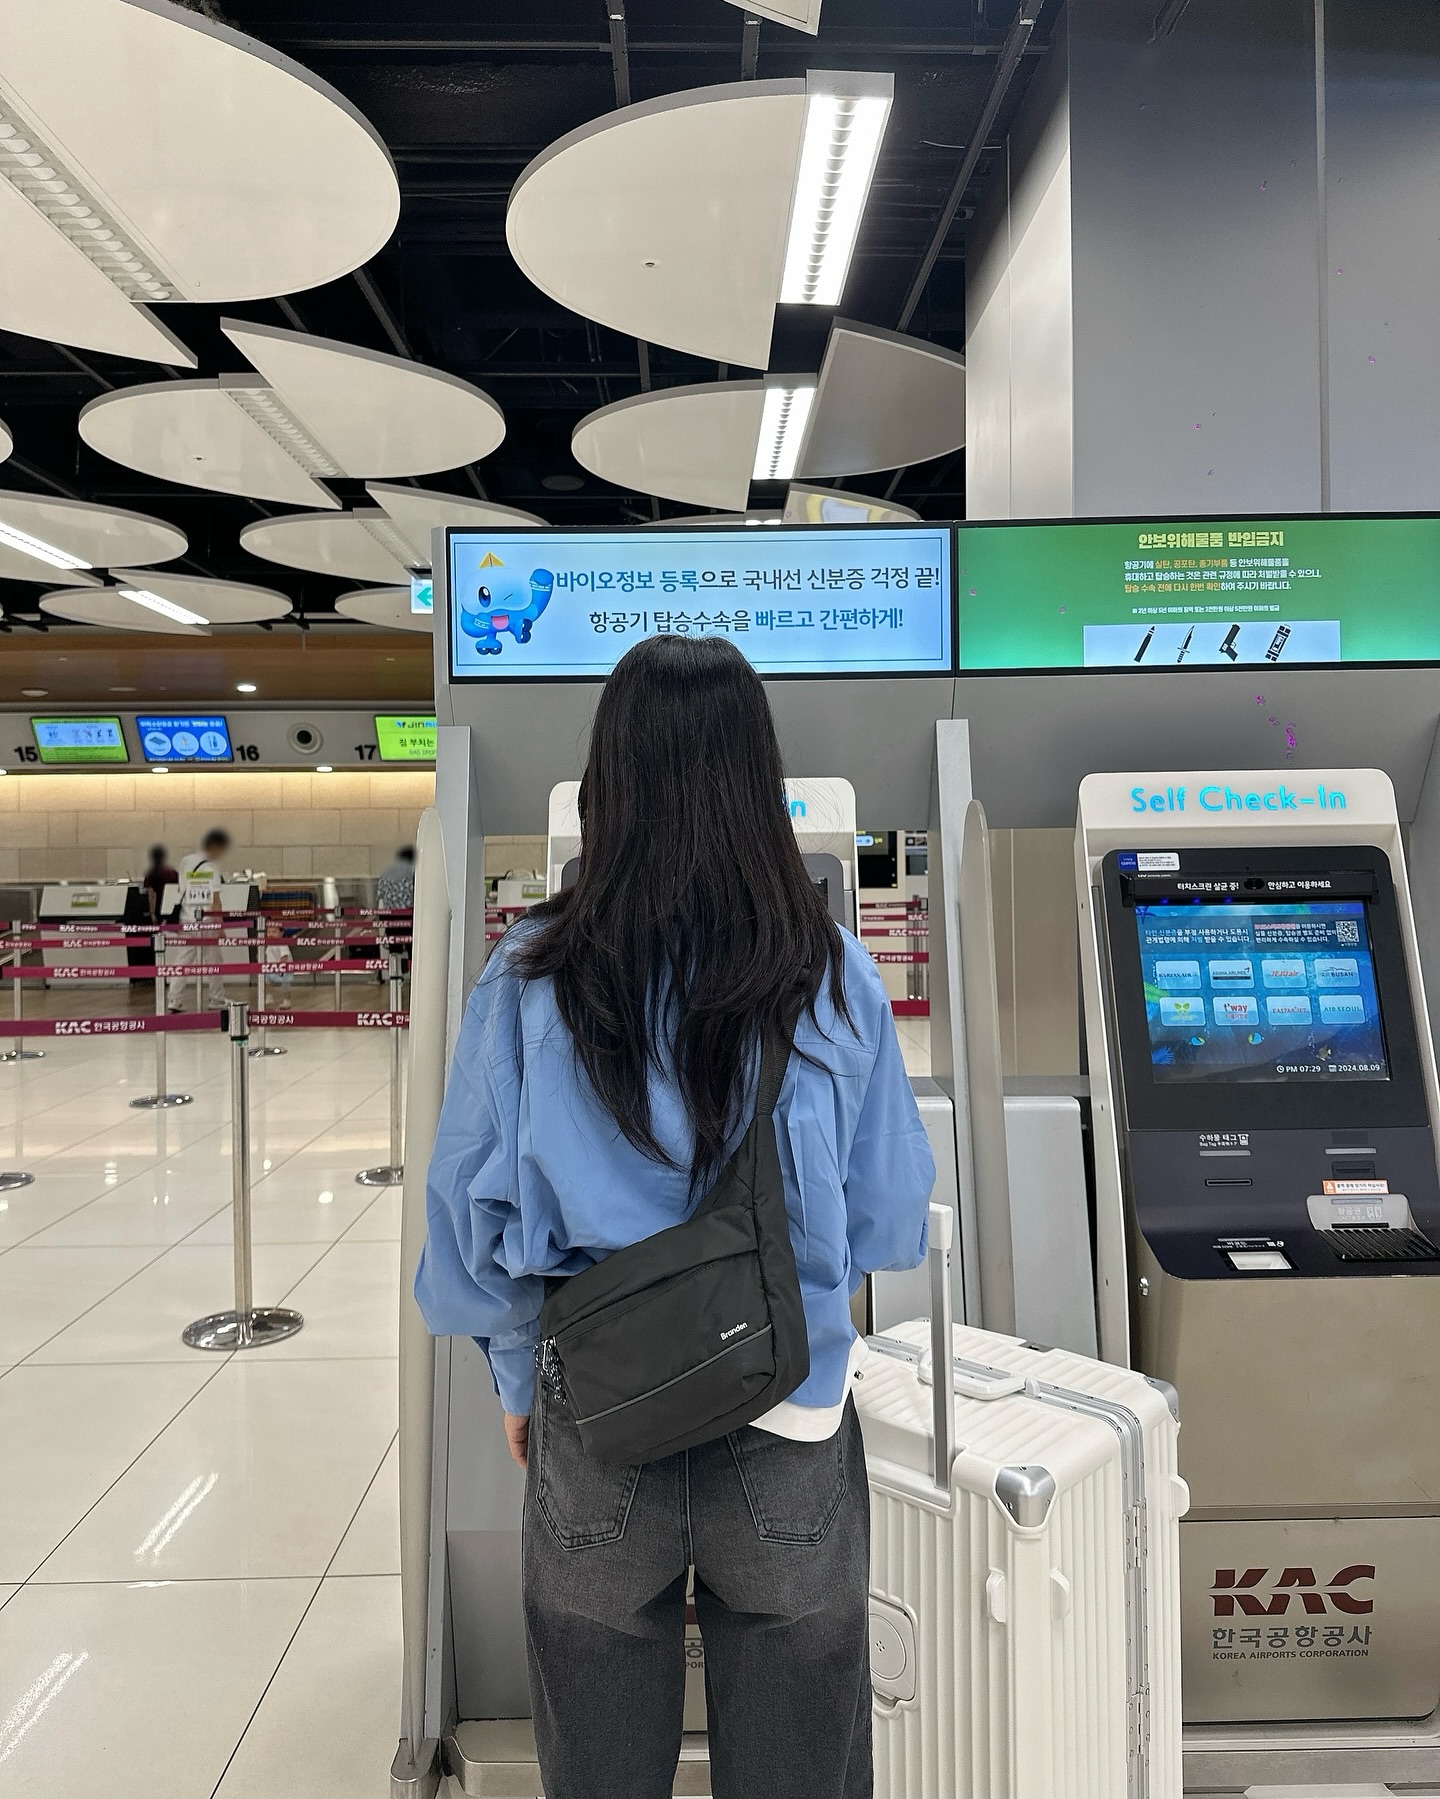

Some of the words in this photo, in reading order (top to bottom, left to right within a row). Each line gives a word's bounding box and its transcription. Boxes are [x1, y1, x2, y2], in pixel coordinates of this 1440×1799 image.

[1138, 532, 1223, 549] 안보위해물품
[1228, 531, 1284, 547] 반입금지
[556, 570, 655, 593] 바이오정보
[659, 570, 739, 593] 등록으로
[742, 568, 802, 591] 국내선
[807, 568, 866, 590] 신분증
[870, 566, 909, 590] 걱정
[914, 567, 940, 588] 끝!
[589, 611, 648, 633] 항공기
[653, 610, 752, 633] 탑승수속을
[755, 609, 815, 631] 빠르고
[820, 608, 904, 630] 간편하게!
[14, 745, 38, 762] 15
[236, 744, 260, 762] 16
[354, 744, 377, 760] 17
[1130, 786, 1187, 813] Self
[1199, 785, 1347, 811] Check-In
[157, 967, 183, 976] KAC
[261, 963, 287, 974] KAC
[365, 960, 389, 969] KAC
[53, 968, 79, 978] KAC
[55, 1020, 91, 1035] KAC
[93, 1020, 145, 1032] 한국공항공사
[250, 1014, 294, 1025] 국공항공사
[357, 1013, 392, 1026] KAC
[1299, 1065, 1321, 1073] 07:29
[1338, 1064, 1380, 1072] 2024.08.09
[720, 1321, 748, 1341] Branden
[1208, 1564, 1376, 1616] KAC
[1212, 1625, 1373, 1649] 한국공항공사
[1212, 1652, 1246, 1660] KOREA
[1249, 1650, 1297, 1660] AIRPORTS
[1299, 1649, 1369, 1659] CORPORATION
